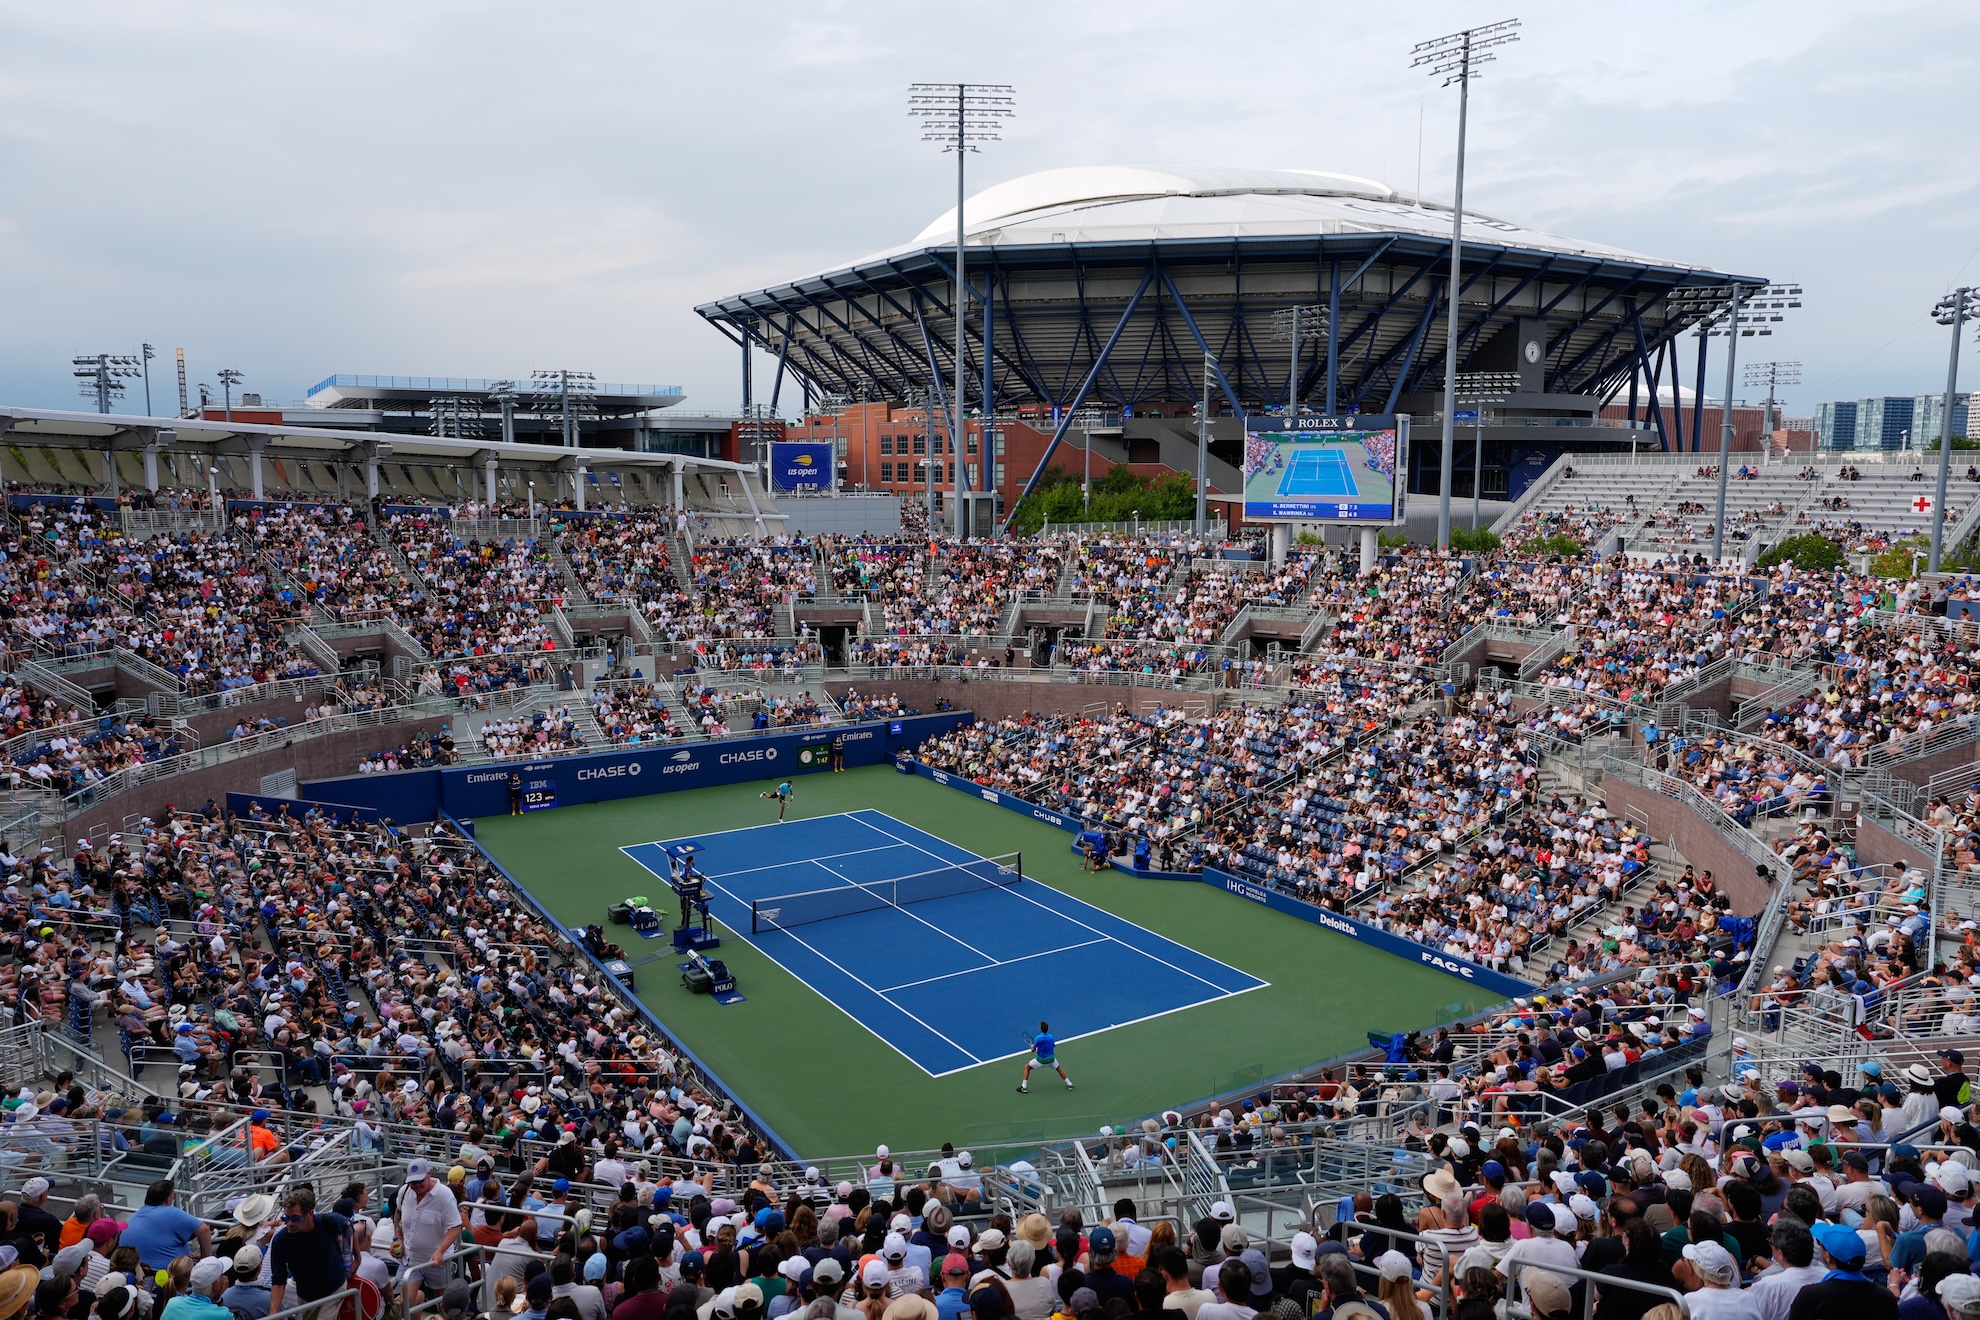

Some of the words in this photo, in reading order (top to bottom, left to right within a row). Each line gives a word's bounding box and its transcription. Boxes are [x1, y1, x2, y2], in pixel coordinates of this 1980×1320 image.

[1298, 418, 1339, 428] ROLEX
[798, 468, 818, 477] open
[841, 730, 873, 742] Emirates
[720, 749, 764, 764] CHASE
[817, 757, 828, 765] 1:47
[577, 765, 627, 781] CHASE
[663, 763, 674, 774] us
[674, 761, 700, 774] open
[467, 771, 508, 784] Emirates
[932, 770, 949, 781] DOBEL
[529, 780, 547, 789] IBM
[525, 792, 543, 803] 123
[1033, 809, 1062, 826] CHUBB
[1226, 878, 1245, 896] IHG
[1246, 886, 1263, 896] HOTELS
[1245, 891, 1267, 903] RESORTS
[1320, 913, 1358, 937] Deloitte.
[1422, 951, 1474, 979] FAGE
[715, 982, 733, 993] POLO
